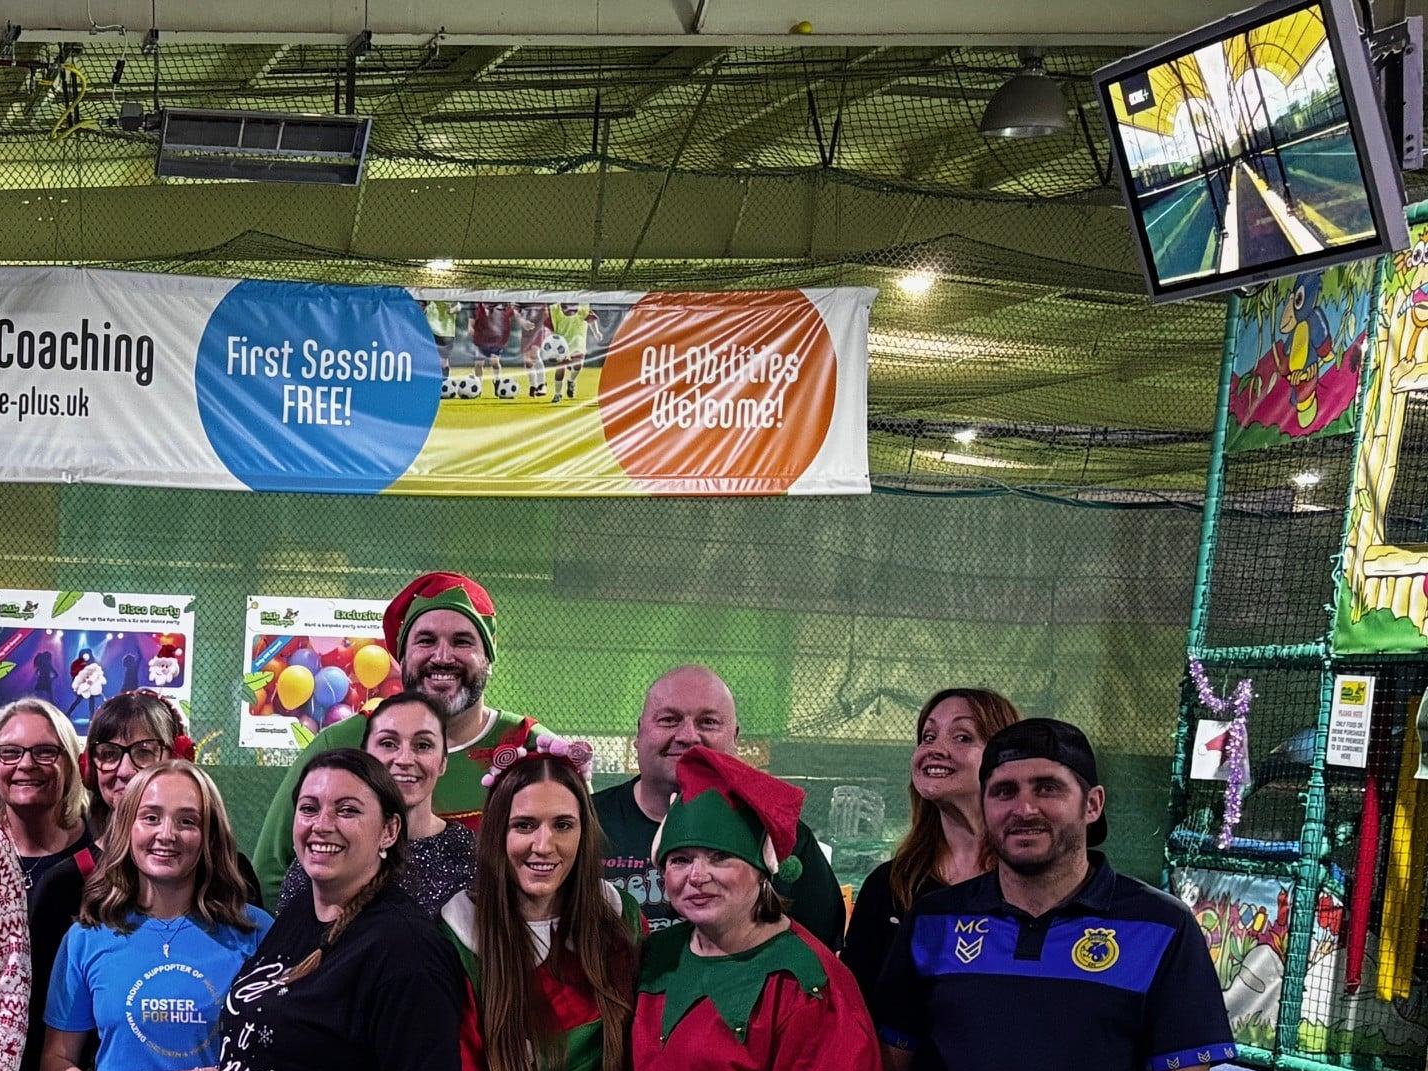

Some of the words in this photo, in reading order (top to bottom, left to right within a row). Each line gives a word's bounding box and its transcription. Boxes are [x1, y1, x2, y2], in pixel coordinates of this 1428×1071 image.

[227, 335, 294, 378] First
[301, 338, 412, 382] Session
[640, 343, 677, 385] All
[685, 343, 800, 385] Abilities
[282, 384, 353, 427] FREE!
[651, 388, 785, 429] Welcome!
[118, 603, 148, 615] Disco
[149, 604, 180, 619] Party
[334, 609, 383, 621] Exclusive
[954, 918, 990, 934] MC
[125, 979, 143, 1006] PROUD
[192, 968, 204, 979] OF
[142, 1011, 169, 1024] FOR
[170, 1011, 207, 1024] HULL
